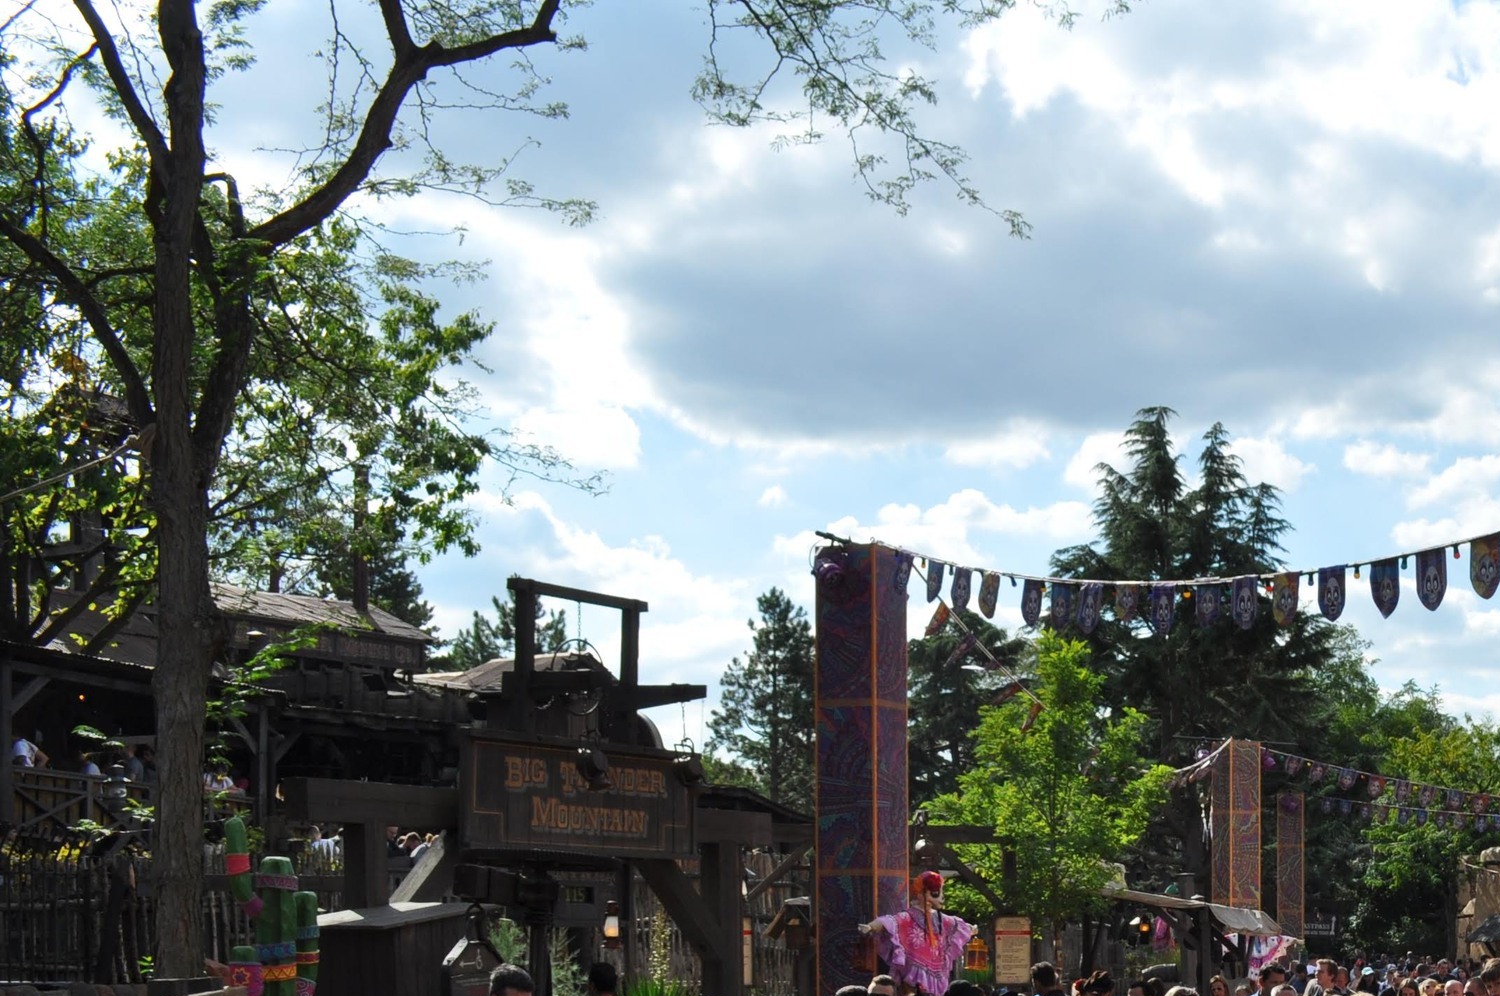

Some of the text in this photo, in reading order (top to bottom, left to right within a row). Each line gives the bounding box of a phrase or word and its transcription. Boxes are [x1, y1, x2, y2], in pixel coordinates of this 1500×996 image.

[504, 756, 666, 796] BIG TNDER
[531, 796, 646, 834] MOUNTAIN
[565, 888, 586, 902] 115
